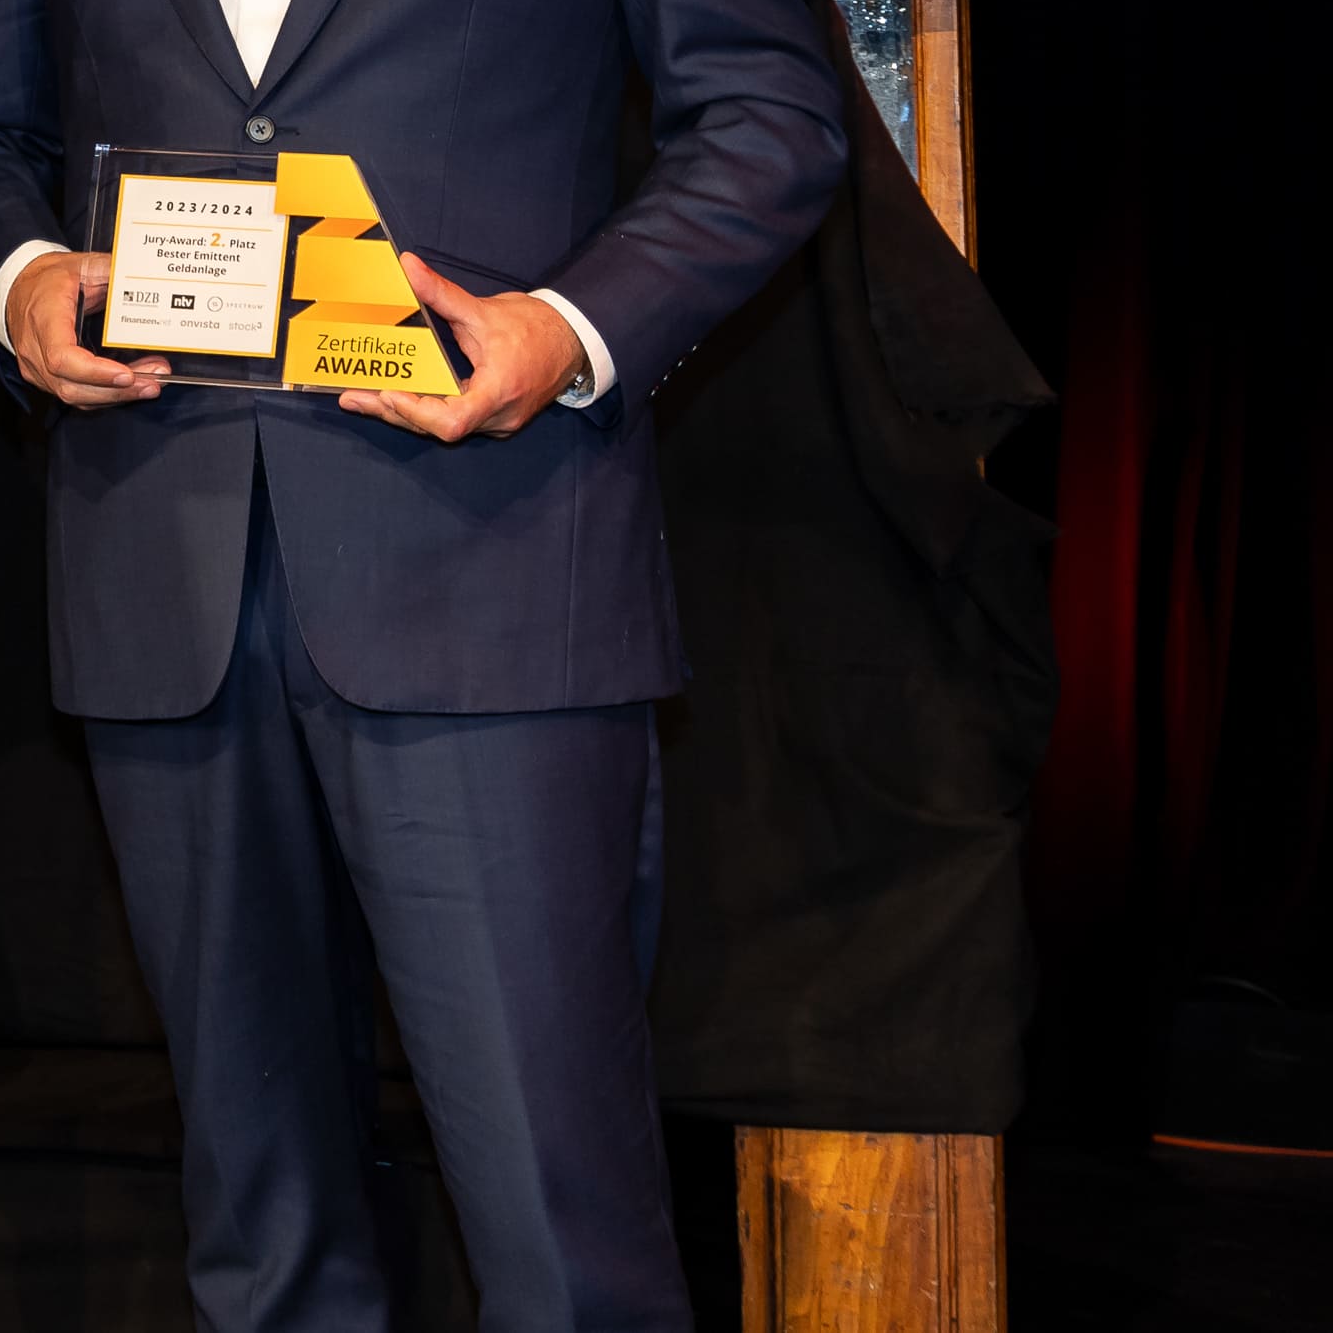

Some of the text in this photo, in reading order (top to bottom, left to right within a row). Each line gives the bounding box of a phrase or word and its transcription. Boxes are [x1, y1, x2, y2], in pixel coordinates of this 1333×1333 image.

[154, 200, 254, 216] 2023/2024
[143, 233, 207, 247] Jury-Award:
[230, 239, 257, 250] Platz
[156, 248, 241, 262] Bester Emittent
[167, 263, 227, 277] Geldanlage
[135, 291, 160, 304] DZB
[173, 296, 193, 309] ntv
[180, 319, 221, 330] onvista
[316, 333, 417, 357] Zertifikate
[314, 355, 414, 380] AWARDS
